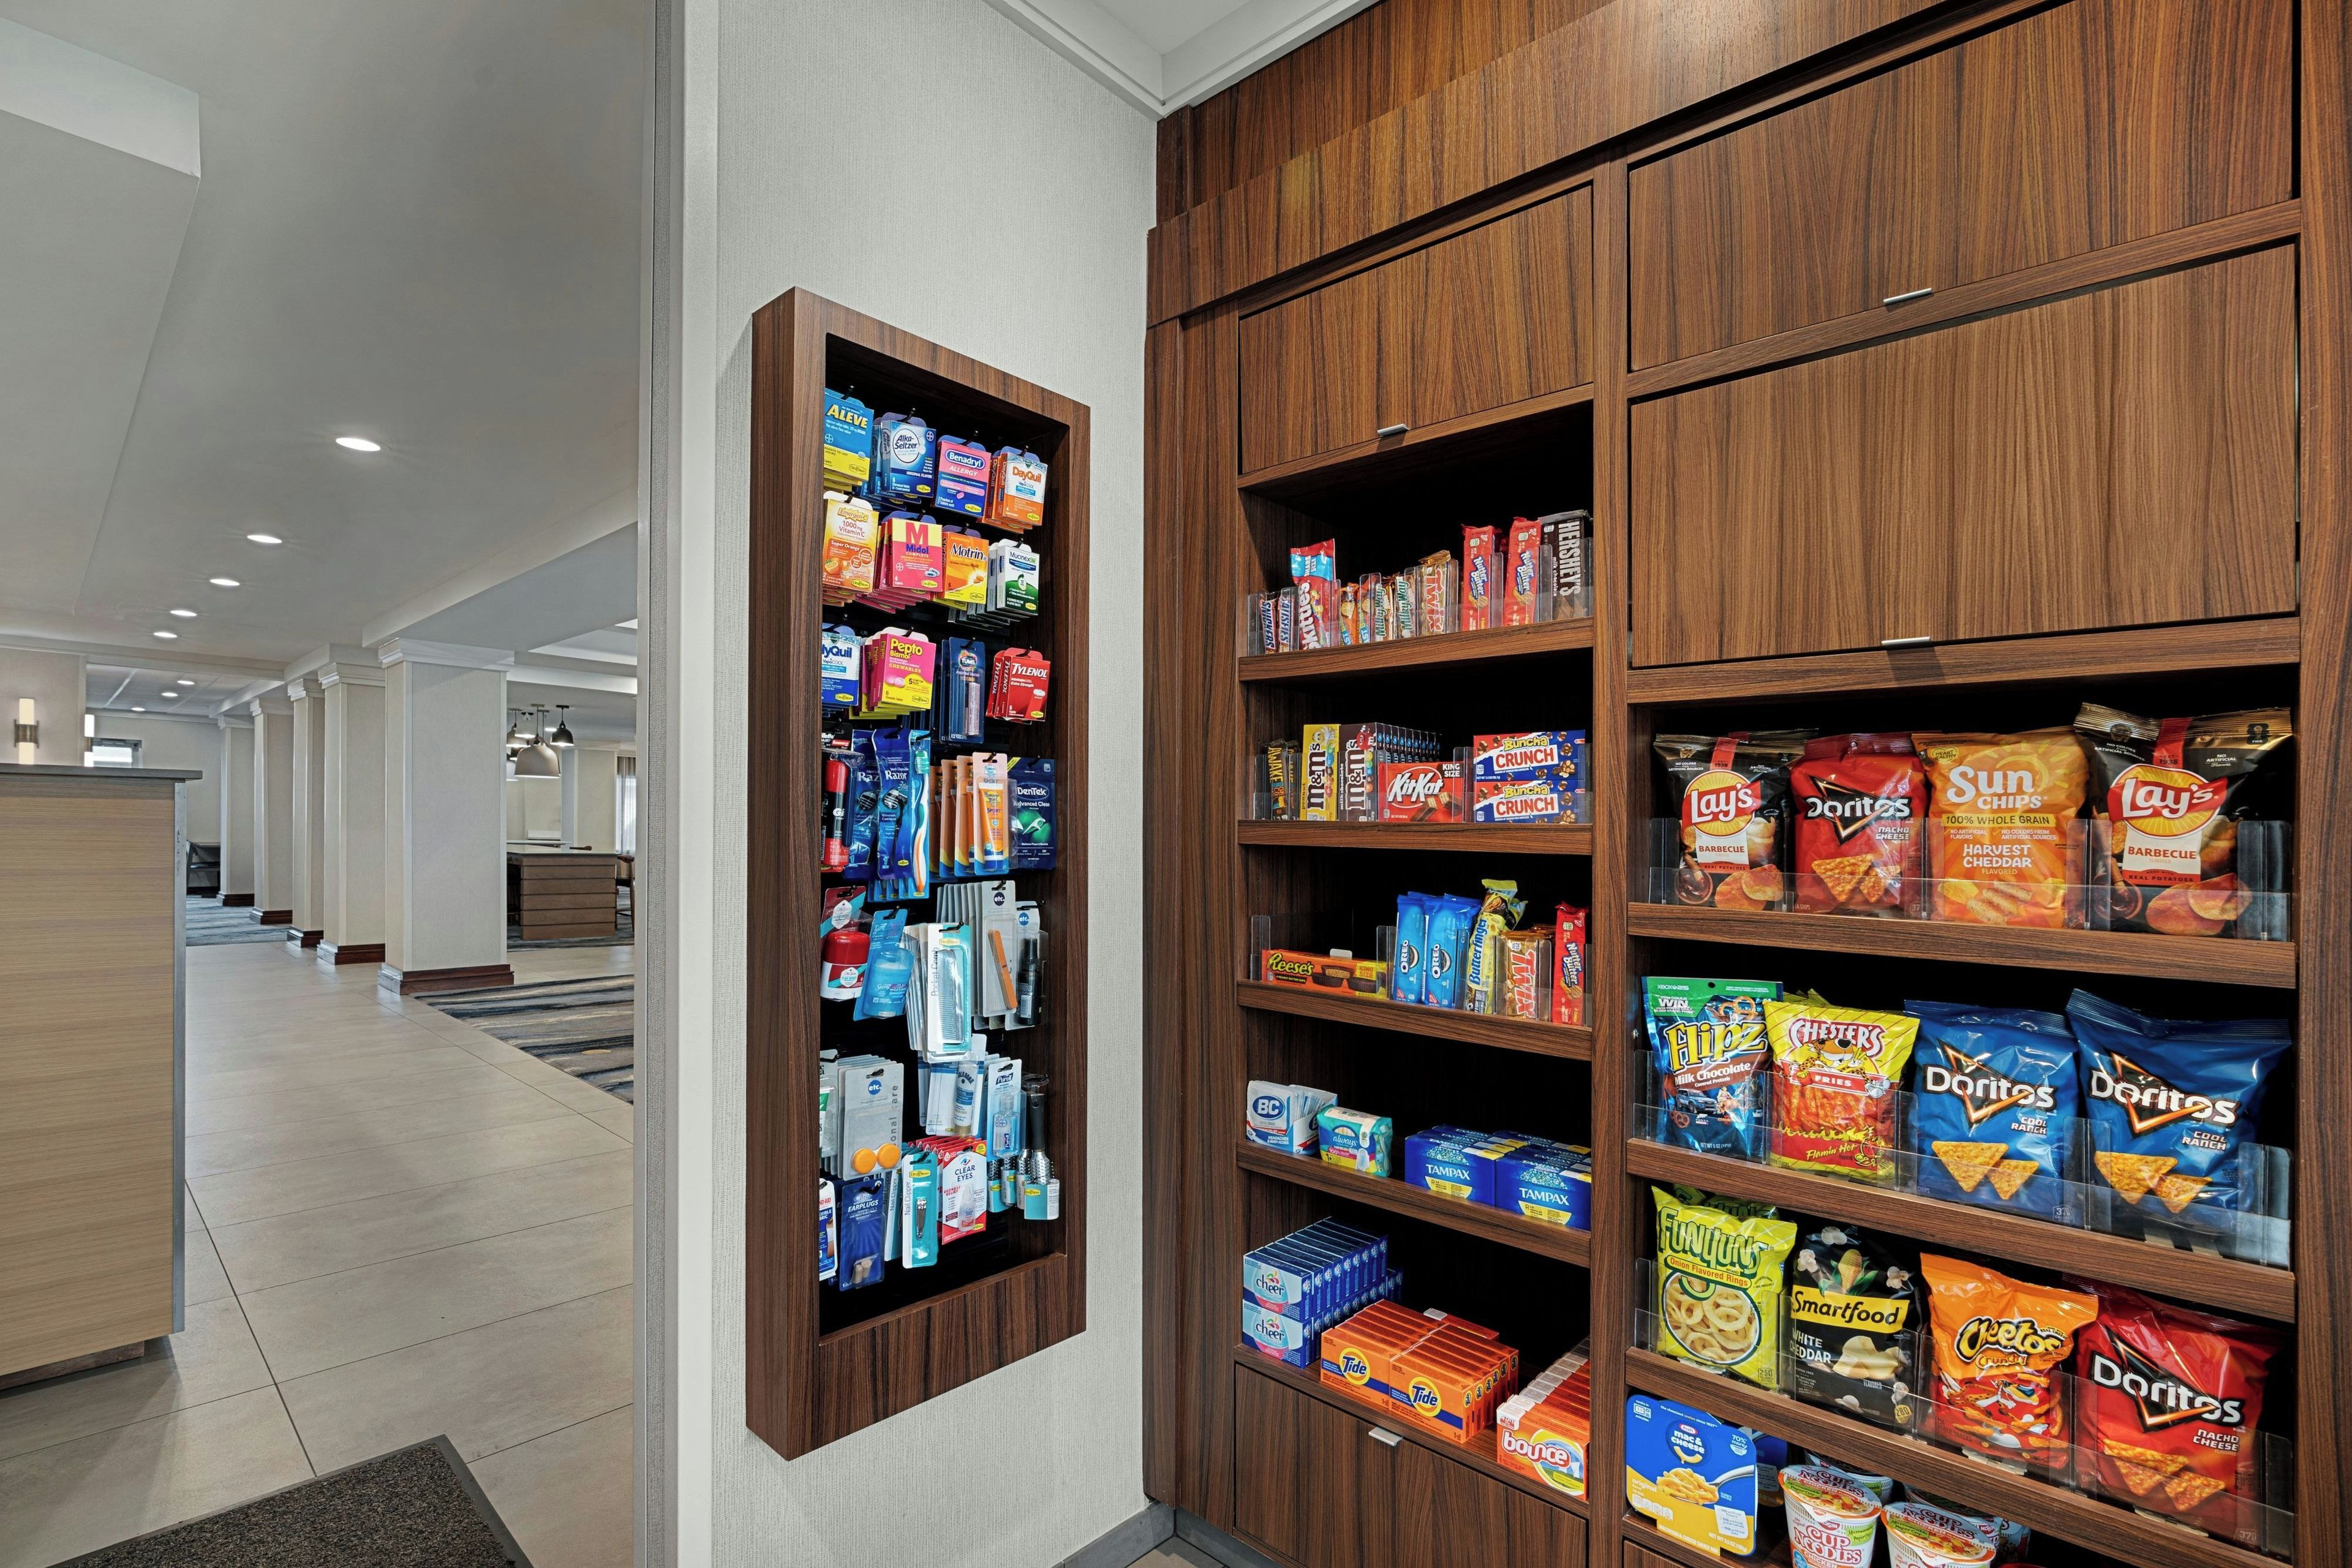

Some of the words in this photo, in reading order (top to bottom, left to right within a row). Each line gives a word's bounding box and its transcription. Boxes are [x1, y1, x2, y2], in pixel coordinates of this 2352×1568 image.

[827, 404, 868, 428] ALEVE
[949, 452, 981, 469] Benadryl
[949, 466, 978, 477] ALLERGY
[1012, 466, 1041, 484] DayQuil
[905, 522, 929, 545] M
[844, 543, 860, 551] Orange
[906, 543, 929, 554] Midol
[1472, 556, 1487, 582] Nutter
[1521, 551, 1534, 578] Nutter
[1558, 521, 1581, 596] HERSHEY'S
[1471, 571, 1483, 595] Butter
[1517, 566, 1530, 594] Butter
[1376, 588, 1387, 608] Way
[1397, 581, 1410, 602] Way
[1425, 568, 1446, 631] TWIX
[1265, 601, 1275, 648] SNICKERS
[1375, 608, 1387, 637] Milky
[1400, 602, 1413, 631] Milky
[890, 650, 911, 660] Bismol
[891, 638, 923, 655] Pepto
[889, 663, 921, 673] CHEWABLES
[992, 662, 1001, 695] TYLENOL
[1012, 663, 1047, 678] TYLENOL
[1503, 736, 1548, 752] Buncha
[1268, 747, 1283, 783] AWAKE
[1496, 747, 1554, 768] CRUNCH
[886, 770, 907, 780] Razor
[1947, 766, 2034, 804] Sun
[1017, 787, 1046, 796] DenTek
[1387, 772, 1443, 804] KitKat
[1504, 785, 1549, 799] Buncha
[2122, 778, 2214, 818] Lay's
[1496, 797, 1554, 816] CRUNCH
[1691, 783, 1753, 823] Lay's
[1806, 797, 1910, 818] Doritos
[1977, 796, 2041, 809] CHIPS
[1946, 816, 1973, 824] 100%
[1977, 815, 2015, 824] WHOLE
[2019, 815, 2049, 824] GRAIN
[1963, 844, 2031, 856] HARVEST
[2128, 846, 2196, 859] BARBECUE
[1963, 858, 2032, 867] CHEDDAR
[1400, 940, 1409, 974] OREO
[1431, 943, 1441, 979] OREO
[1469, 918, 1487, 986] Butterfinger
[1566, 941, 1582, 971] Nutter
[1267, 953, 1314, 976] Reese's
[1562, 956, 1578, 985] Butter
[1510, 949, 1537, 1019] TWIX
[1658, 998, 1689, 1008] WIN
[1665, 1022, 1767, 1072] Flipz
[1790, 1019, 1884, 1056] CHESTER'S
[1675, 1074, 1695, 1087] Milk
[1697, 1062, 1751, 1080] Chocolate
[1815, 1076, 1852, 1087] FRIES
[1926, 1066, 2056, 1109] Doritos
[2090, 1071, 2237, 1125] Doritos
[1258, 1099, 1280, 1115] BC
[2011, 1123, 2047, 1134] RANCH
[2021, 1117, 2047, 1126] COOL
[1333, 1134, 1359, 1147] always
[2182, 1137, 2226, 1151] RANCH
[2193, 1131, 2226, 1143] COOL
[955, 1165, 975, 1175] CLEAR
[957, 1173, 973, 1182] EYES
[1426, 1164, 1470, 1180] TAMPAX
[848, 1199, 879, 1213] EARPLUGS
[1519, 1188, 1569, 1205] TAMPAX
[1659, 1207, 1769, 1275] FUNYUNS
[1670, 1257, 1691, 1270] Onion
[1692, 1263, 1724, 1280] Flavored
[1727, 1272, 1749, 1286] Rings
[1256, 1274, 1284, 1296] cheer
[1794, 1290, 1900, 1325] Smartfood
[1256, 1318, 1284, 1341] cheer
[1792, 1327, 1823, 1348] WHITE
[1960, 1320, 2062, 1358] Cheetos
[1342, 1356, 1367, 1376] Tide
[1977, 1354, 2027, 1366] Crunchy
[1863, 1379, 1882, 1390] FLAVORED
[2094, 1355, 2242, 1424] Doritos
[1411, 1385, 1438, 1407] Tide
[1896, 1407, 1909, 1416] 280
[1674, 1431, 1694, 1444] mac
[1694, 1437, 1702, 1446] &
[2192, 1436, 2239, 1451] CHEESE
[2197, 1428, 2239, 1442] NACHO
[1503, 1431, 1568, 1464] bounce
[1632, 1479, 1656, 1492] original
[1798, 1470, 1864, 1498] NOODLES
[1902, 1507, 1975, 1540] NOODLES
[1921, 1509, 1962, 1527] CUP
[1794, 1527, 1861, 1564] NOODLES
[1807, 1525, 1850, 1550] CUP
